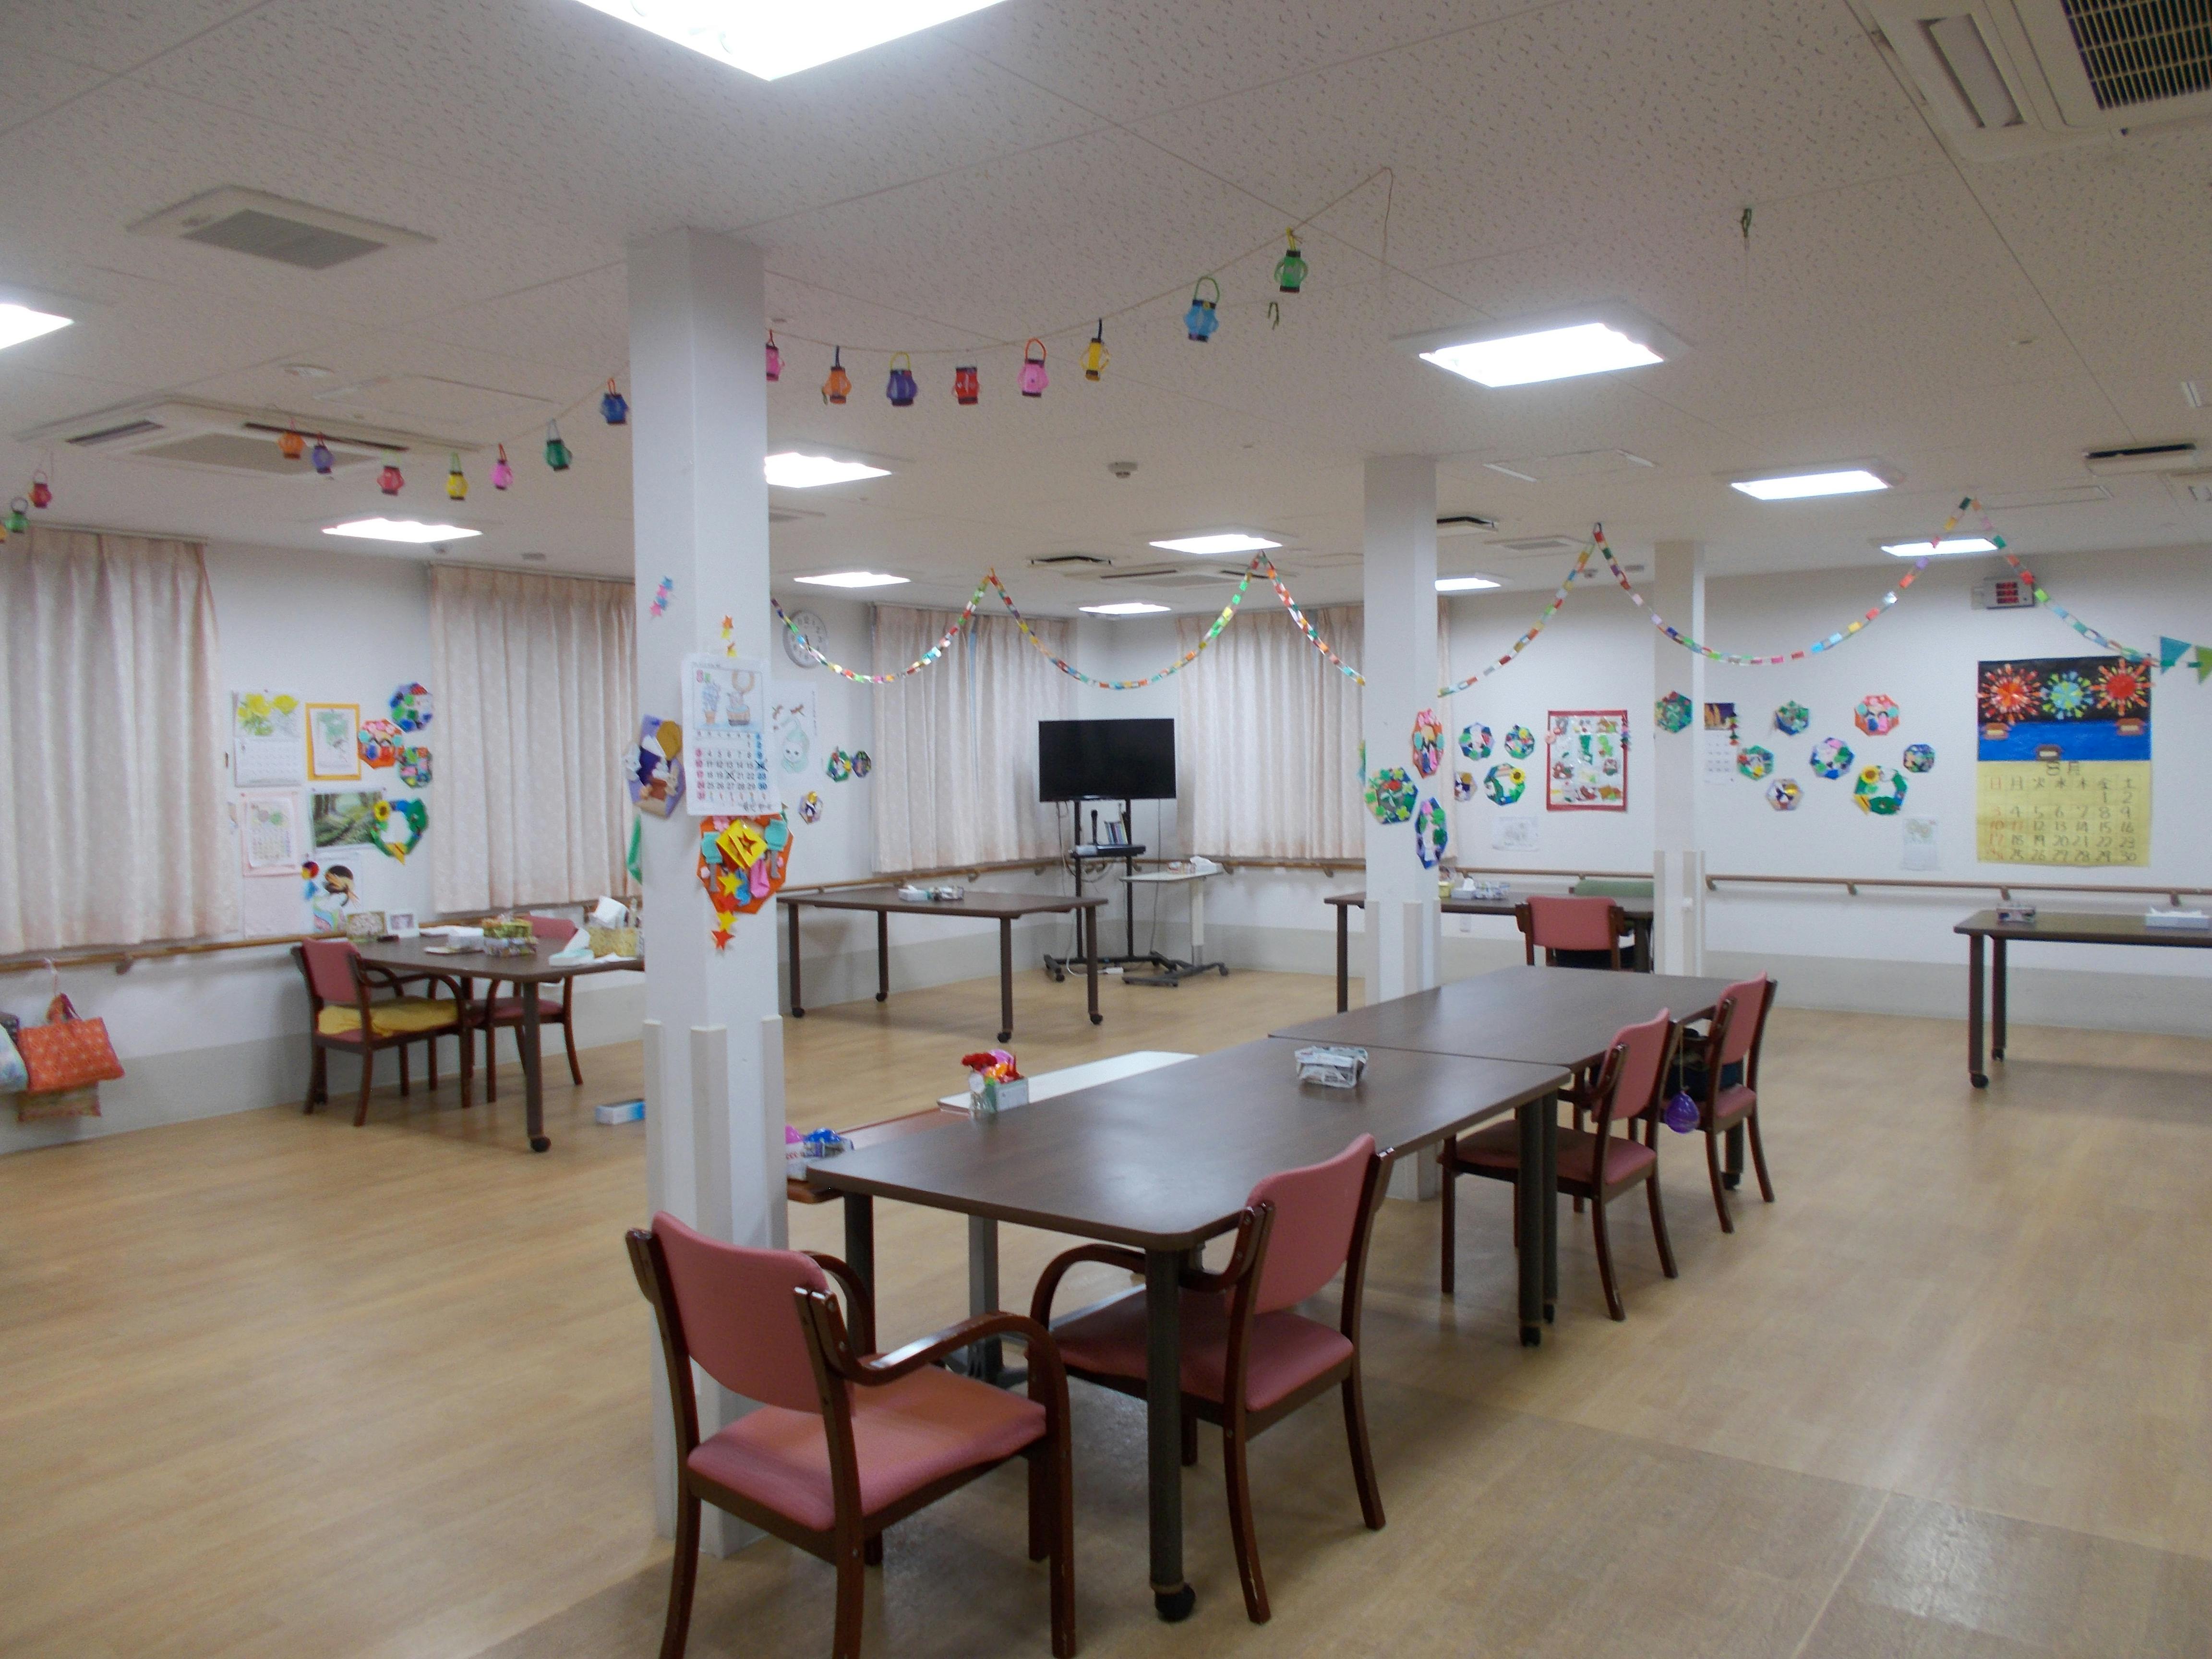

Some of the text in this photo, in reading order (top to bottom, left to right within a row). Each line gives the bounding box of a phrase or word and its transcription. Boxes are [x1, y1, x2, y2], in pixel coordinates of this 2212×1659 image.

[2033, 777, 2045, 789] 火
[2103, 792, 2133, 804] 1 2
[2056, 806, 2064, 817] 6
[2077, 806, 2088, 817] 7
[2099, 807, 2111, 818] 8
[2120, 806, 2130, 819] 9
[2034, 821, 2045, 830] 12
[2056, 821, 2067, 831] 13
[2076, 821, 2088, 832] 14
[2100, 822, 2112, 833] 15
[2121, 822, 2134, 833] 16
[2012, 835, 2024, 846] 18
[2034, 834, 2045, 846] 19
[2053, 835, 2069, 846] 20
[2072, 835, 2088, 847] 21
[2097, 836, 2112, 847] 22
[2119, 836, 2135, 849] 23
[2120, 851, 2137, 861] 30
